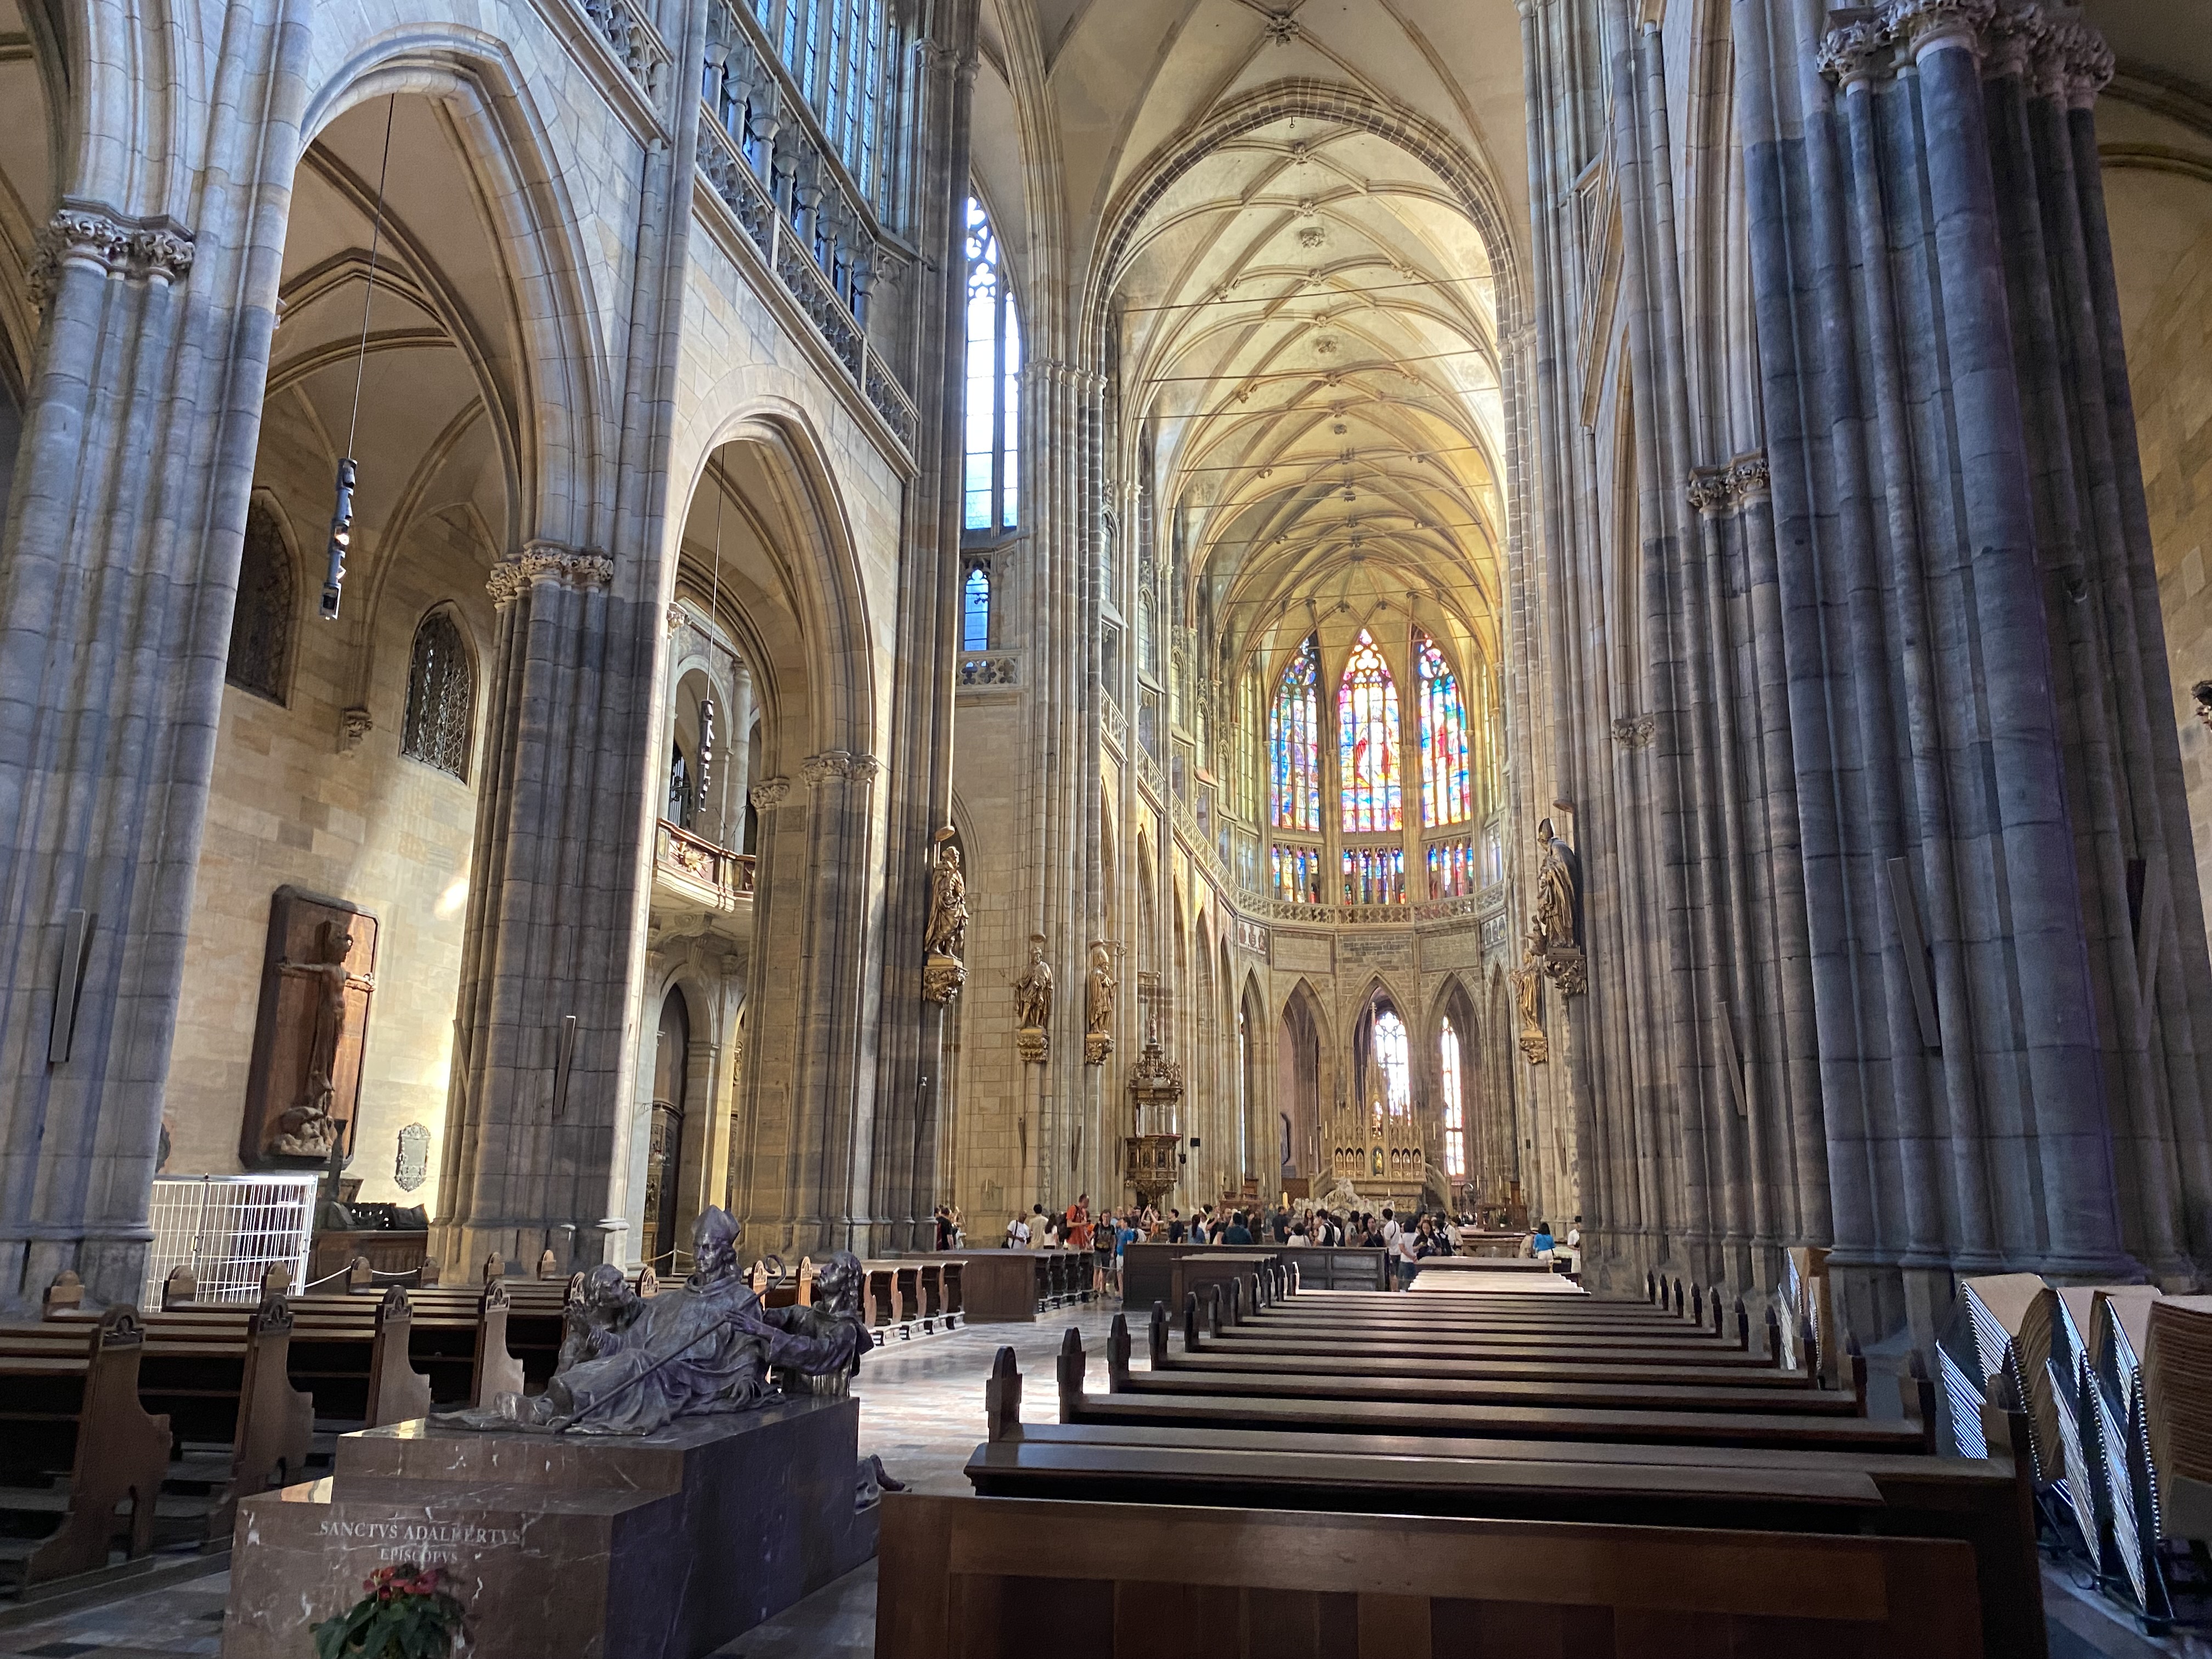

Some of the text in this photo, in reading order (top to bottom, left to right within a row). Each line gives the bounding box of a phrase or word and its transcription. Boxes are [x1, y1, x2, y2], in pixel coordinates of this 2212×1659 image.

[320, 1521, 521, 1543] SANCTVS ADALBERTVS
[380, 1548, 458, 1563] EPISCOPVS
